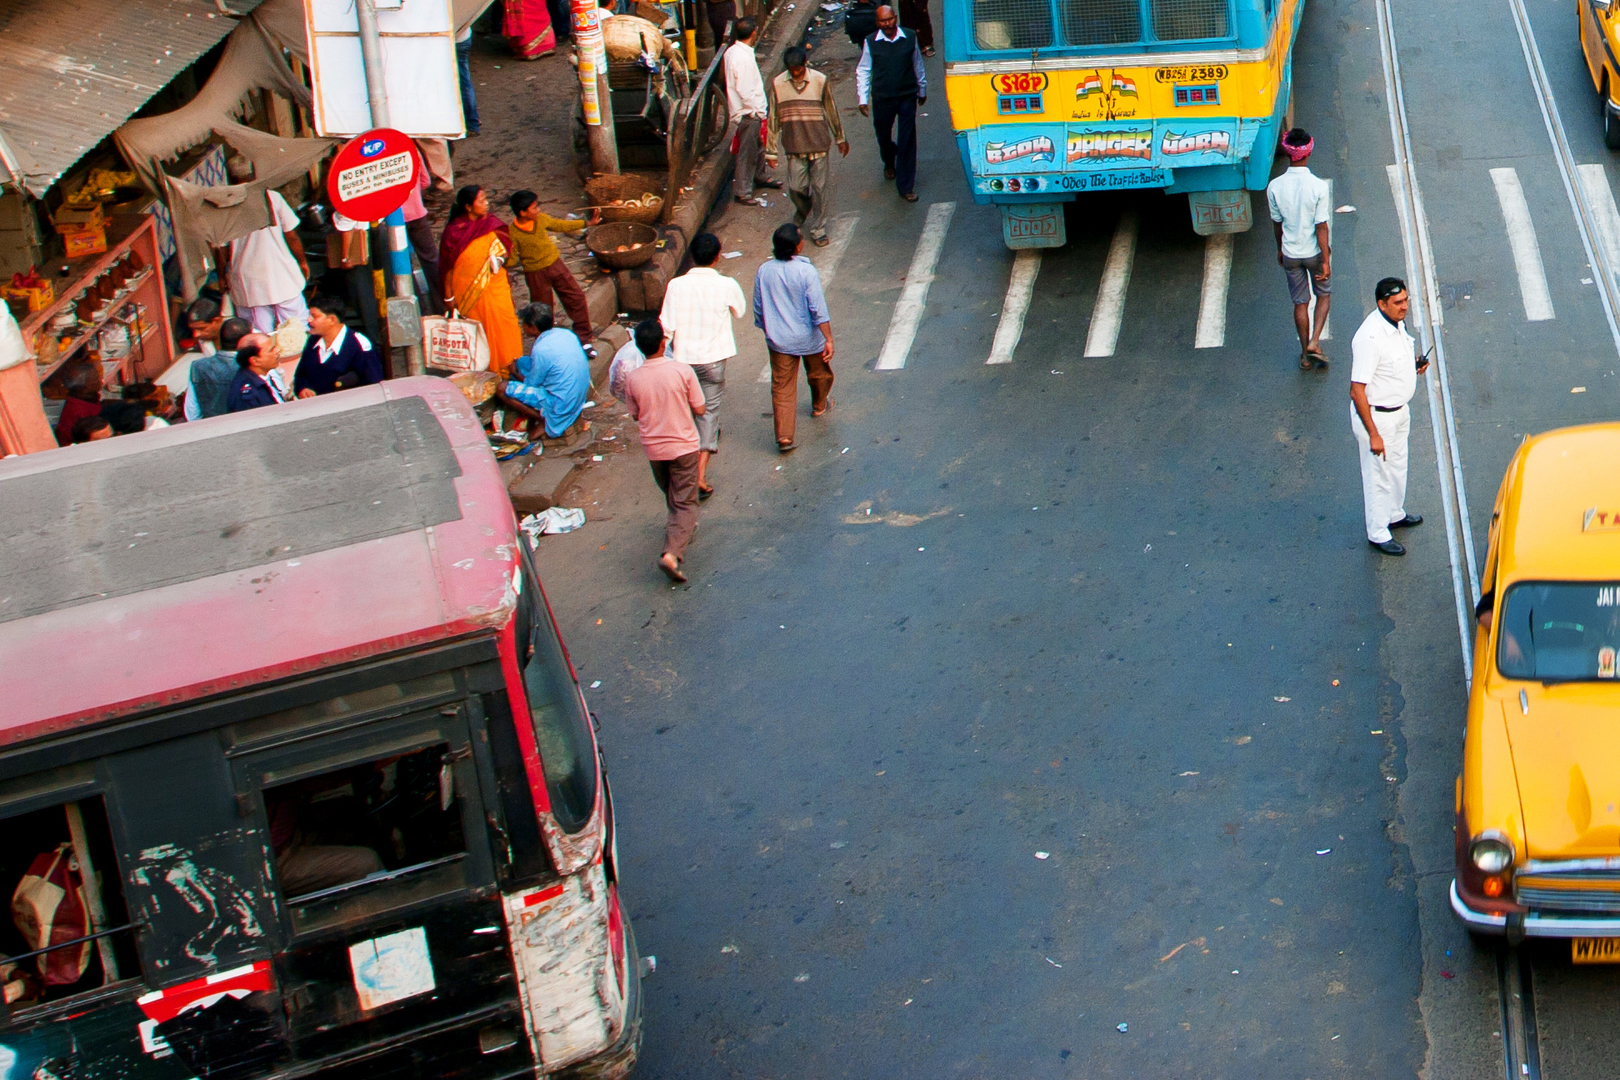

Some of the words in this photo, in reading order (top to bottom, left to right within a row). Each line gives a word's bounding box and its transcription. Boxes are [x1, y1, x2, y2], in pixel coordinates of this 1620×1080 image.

[1001, 73, 1042, 93] STOP
[1190, 67, 1225, 80] 2389
[985, 136, 1053, 164] BLOW
[1067, 130, 1152, 161] DANGER
[1162, 131, 1230, 157] HORN
[342, 172, 353, 181] NO
[354, 163, 378, 178] ENTRY
[379, 155, 407, 170] EXCEPT
[342, 179, 364, 191] BUSES
[372, 164, 409, 180] MINIBUSES
[1061, 176, 1087, 190] Obey
[1089, 174, 1108, 186] The
[1108, 174, 1140, 187] Traffic
[1010, 217, 1056, 237] GOOD
[1596, 586, 1613, 606] JAI
